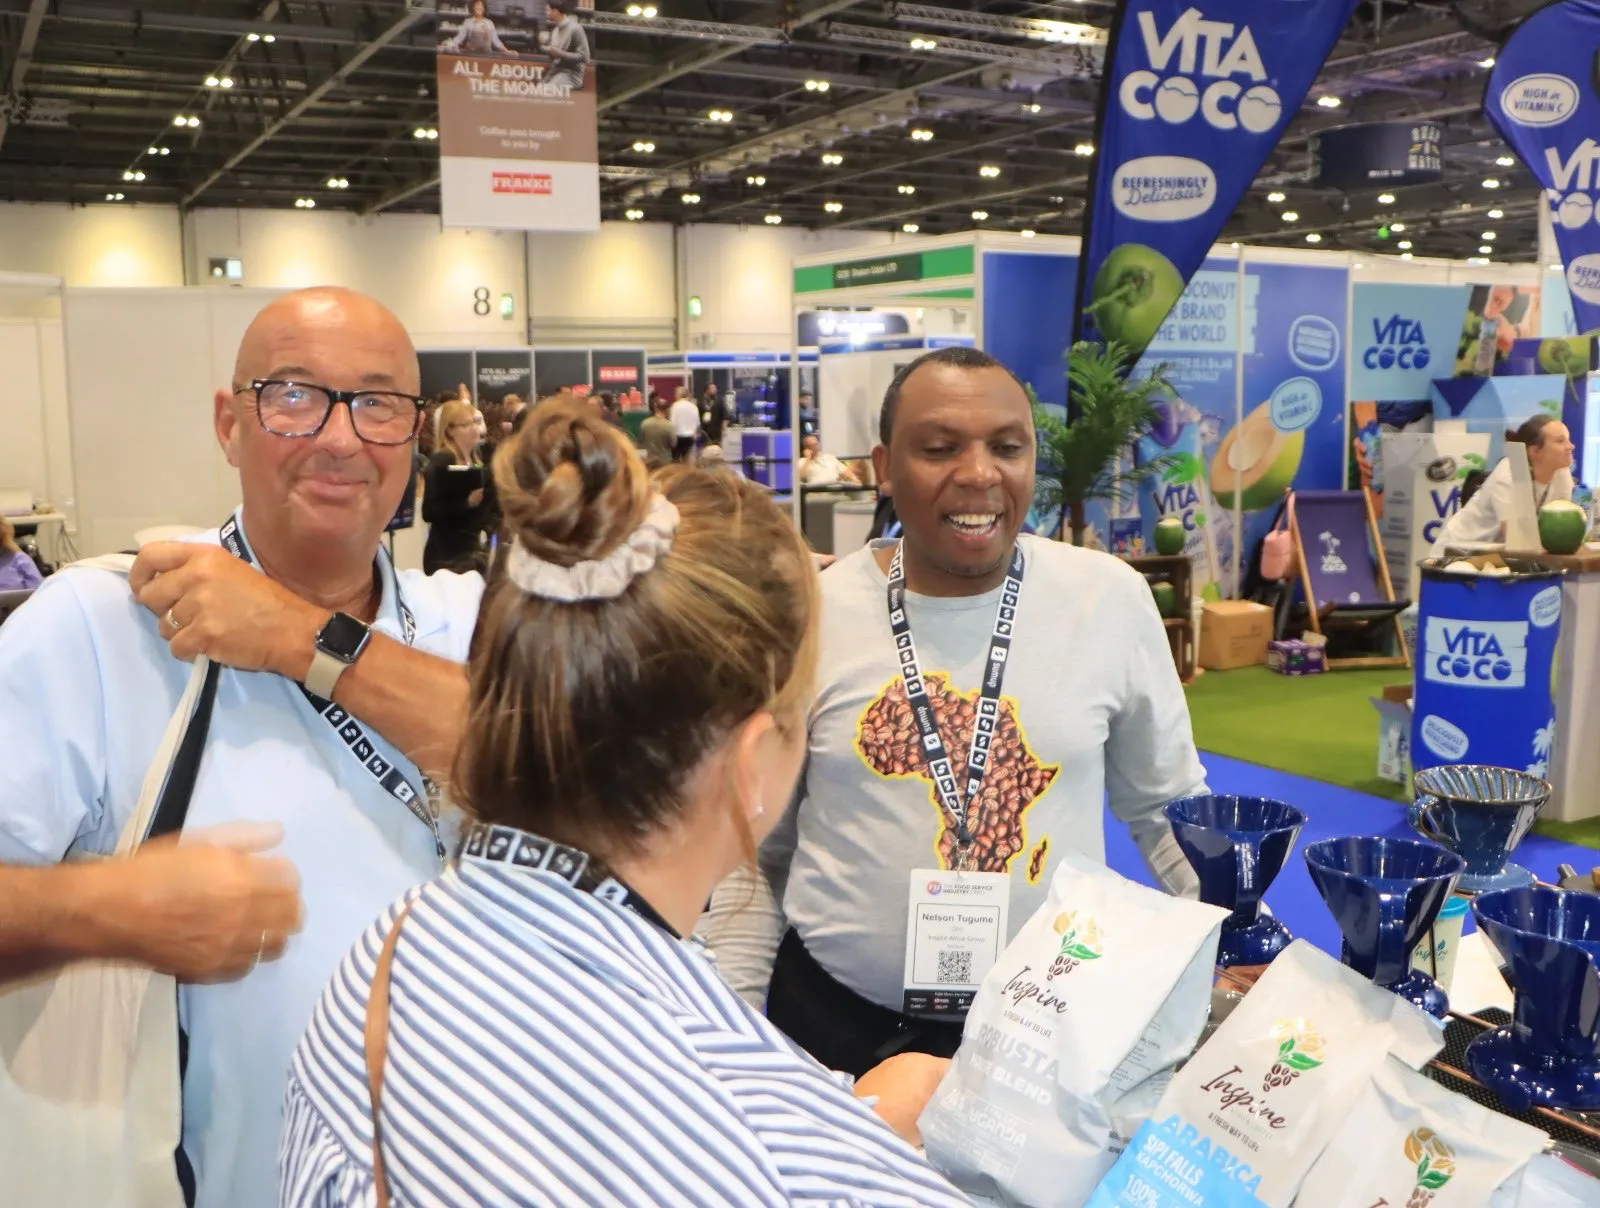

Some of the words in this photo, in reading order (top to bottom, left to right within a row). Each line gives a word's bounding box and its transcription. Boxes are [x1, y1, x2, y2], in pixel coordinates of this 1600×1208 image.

[1137, 7, 1268, 82] VITA
[454, 60, 483, 76] ALL
[490, 64, 544, 79] ABOUT
[469, 78, 501, 94] THE
[504, 82, 573, 98] MOMENT
[1119, 70, 1282, 133] COCO
[1522, 88, 1549, 98] HIGH
[1514, 100, 1555, 112] VITAMIN
[493, 178, 552, 190] FRANKE
[1122, 176, 1208, 189] REFRESHINGLY
[1125, 187, 1205, 206] Delicious
[473, 286, 491, 316] 8
[1181, 303, 1226, 320] BRAND
[1179, 324, 1226, 342] WORLD
[1373, 314, 1425, 345] VITA
[1363, 346, 1430, 370] COCO
[1152, 482, 1200, 516] VITA
[1443, 626, 1504, 656] VITA
[986, 661, 1000, 688] sumup
[1436, 654, 1512, 681] COCO
[917, 705, 931, 733] sumup
[922, 913, 954, 922] Nelson
[957, 914, 994, 924] Tugume
[1001, 965, 1068, 1014] Inspire
[1033, 1023, 1041, 1033] TO
[1040, 1027, 1053, 1038] LIFE
[978, 1023, 1060, 1084] ROBUSTA
[992, 1066, 1052, 1106] BLEND
[1200, 1065, 1287, 1128] Inspire
[1213, 1114, 1229, 1131] FRESH
[1229, 1126, 1242, 1138] WAY
[1242, 1134, 1249, 1145] TO
[1248, 1139, 1260, 1153] LIFE
[1144, 1134, 1170, 1161] SIPI
[1164, 1150, 1204, 1186] FALLS
[1160, 1114, 1263, 1194] ARABICA
[1125, 1173, 1160, 1200] 100%
[1136, 1151, 1204, 1207] KAPCHORWA
